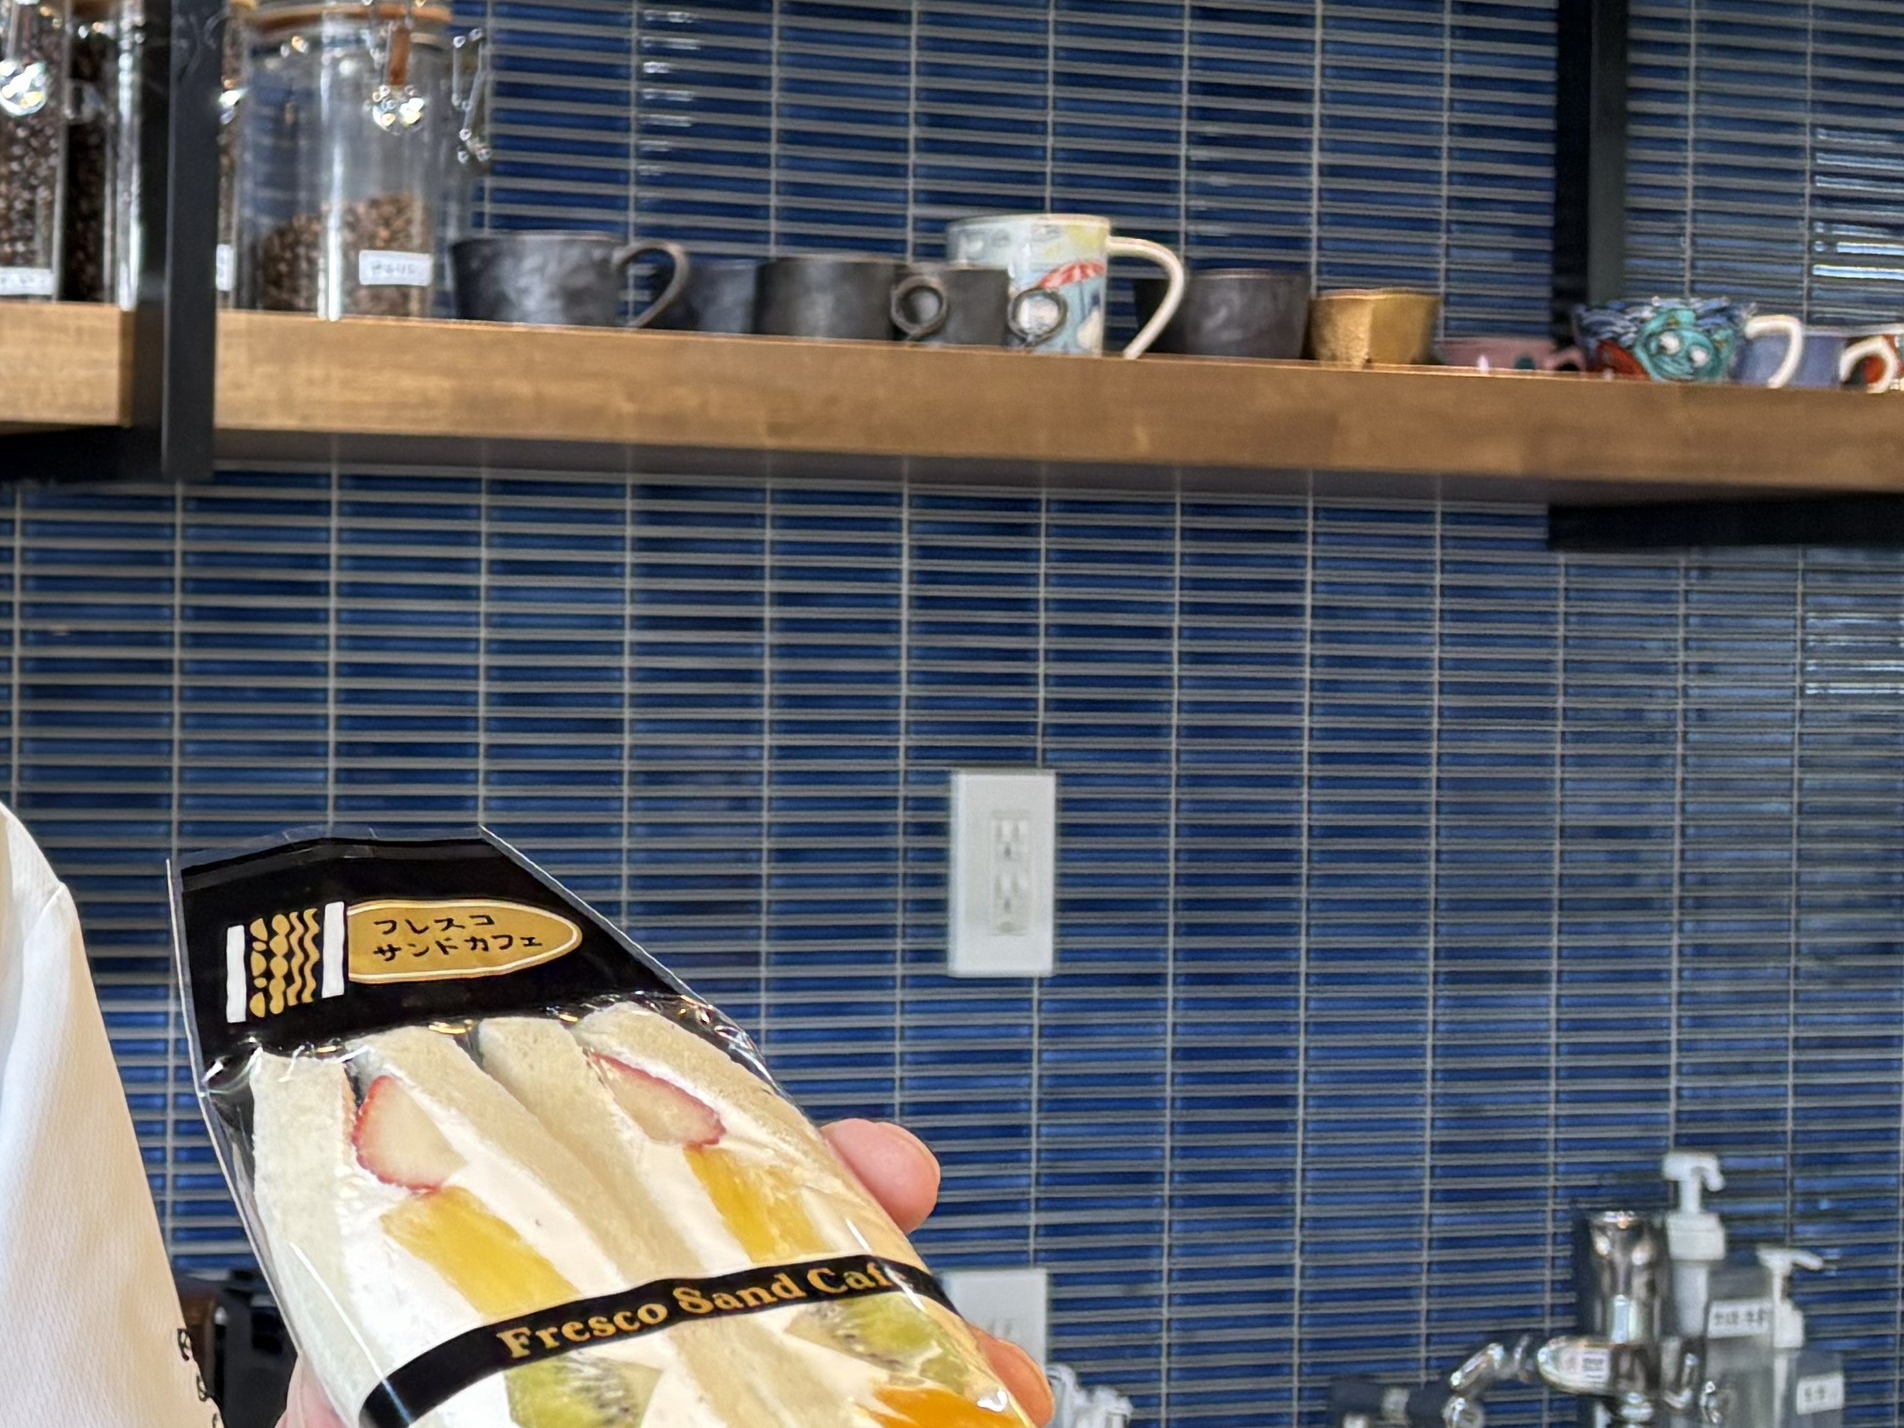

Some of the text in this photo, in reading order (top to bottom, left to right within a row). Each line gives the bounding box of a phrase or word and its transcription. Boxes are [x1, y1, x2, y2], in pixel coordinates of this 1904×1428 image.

[373, 914, 495, 935] フレスコ
[373, 933, 543, 962] サンドカフェ
[495, 1300, 668, 1360] Fresco
[672, 1274, 807, 1316] Sand
